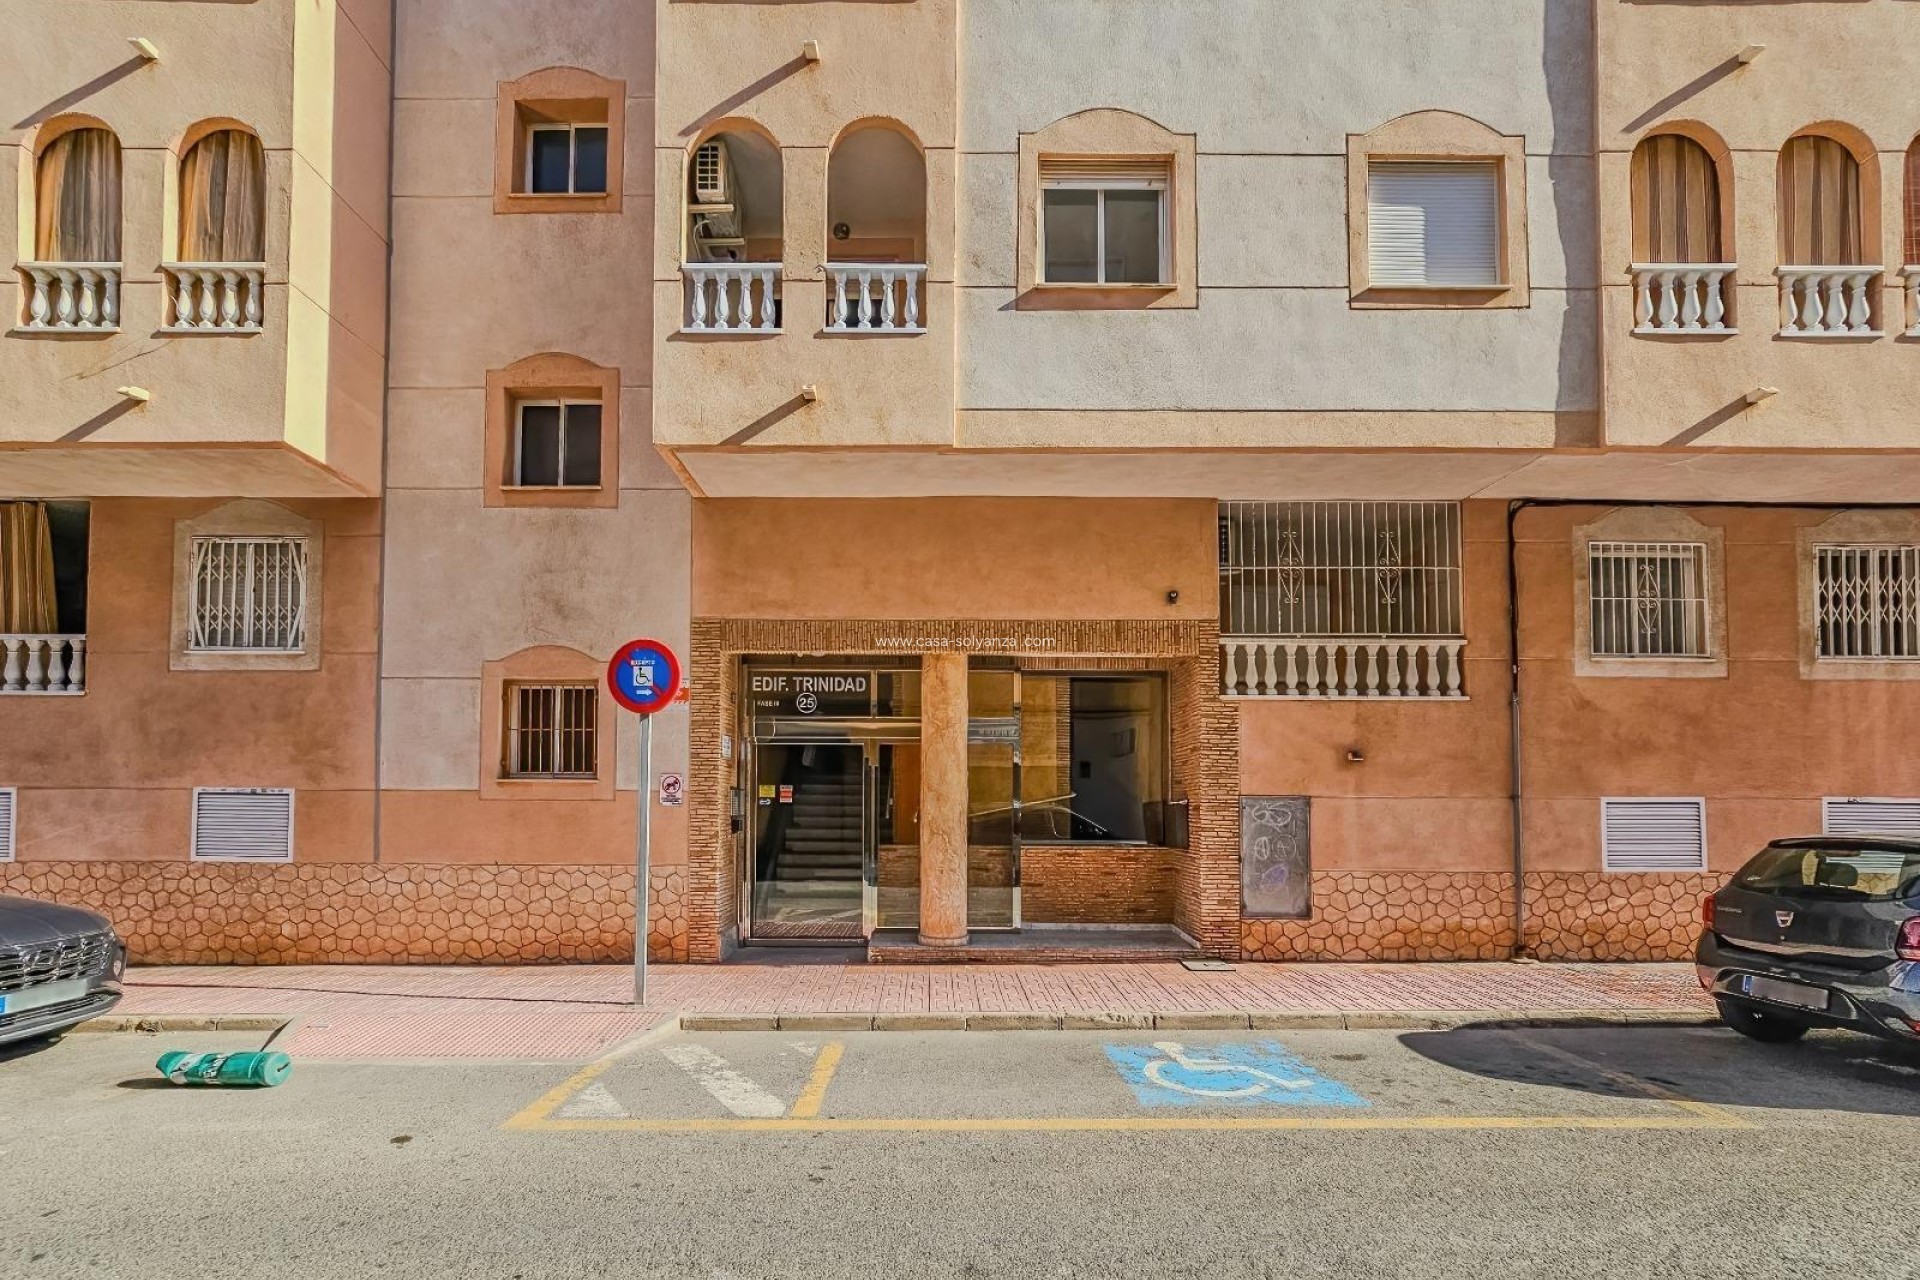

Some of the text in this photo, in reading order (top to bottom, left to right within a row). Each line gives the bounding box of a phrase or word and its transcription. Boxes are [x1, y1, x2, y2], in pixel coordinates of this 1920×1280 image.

[752, 676, 867, 692] EDIF. TRINIDAD
[799, 697, 815, 708] 25
